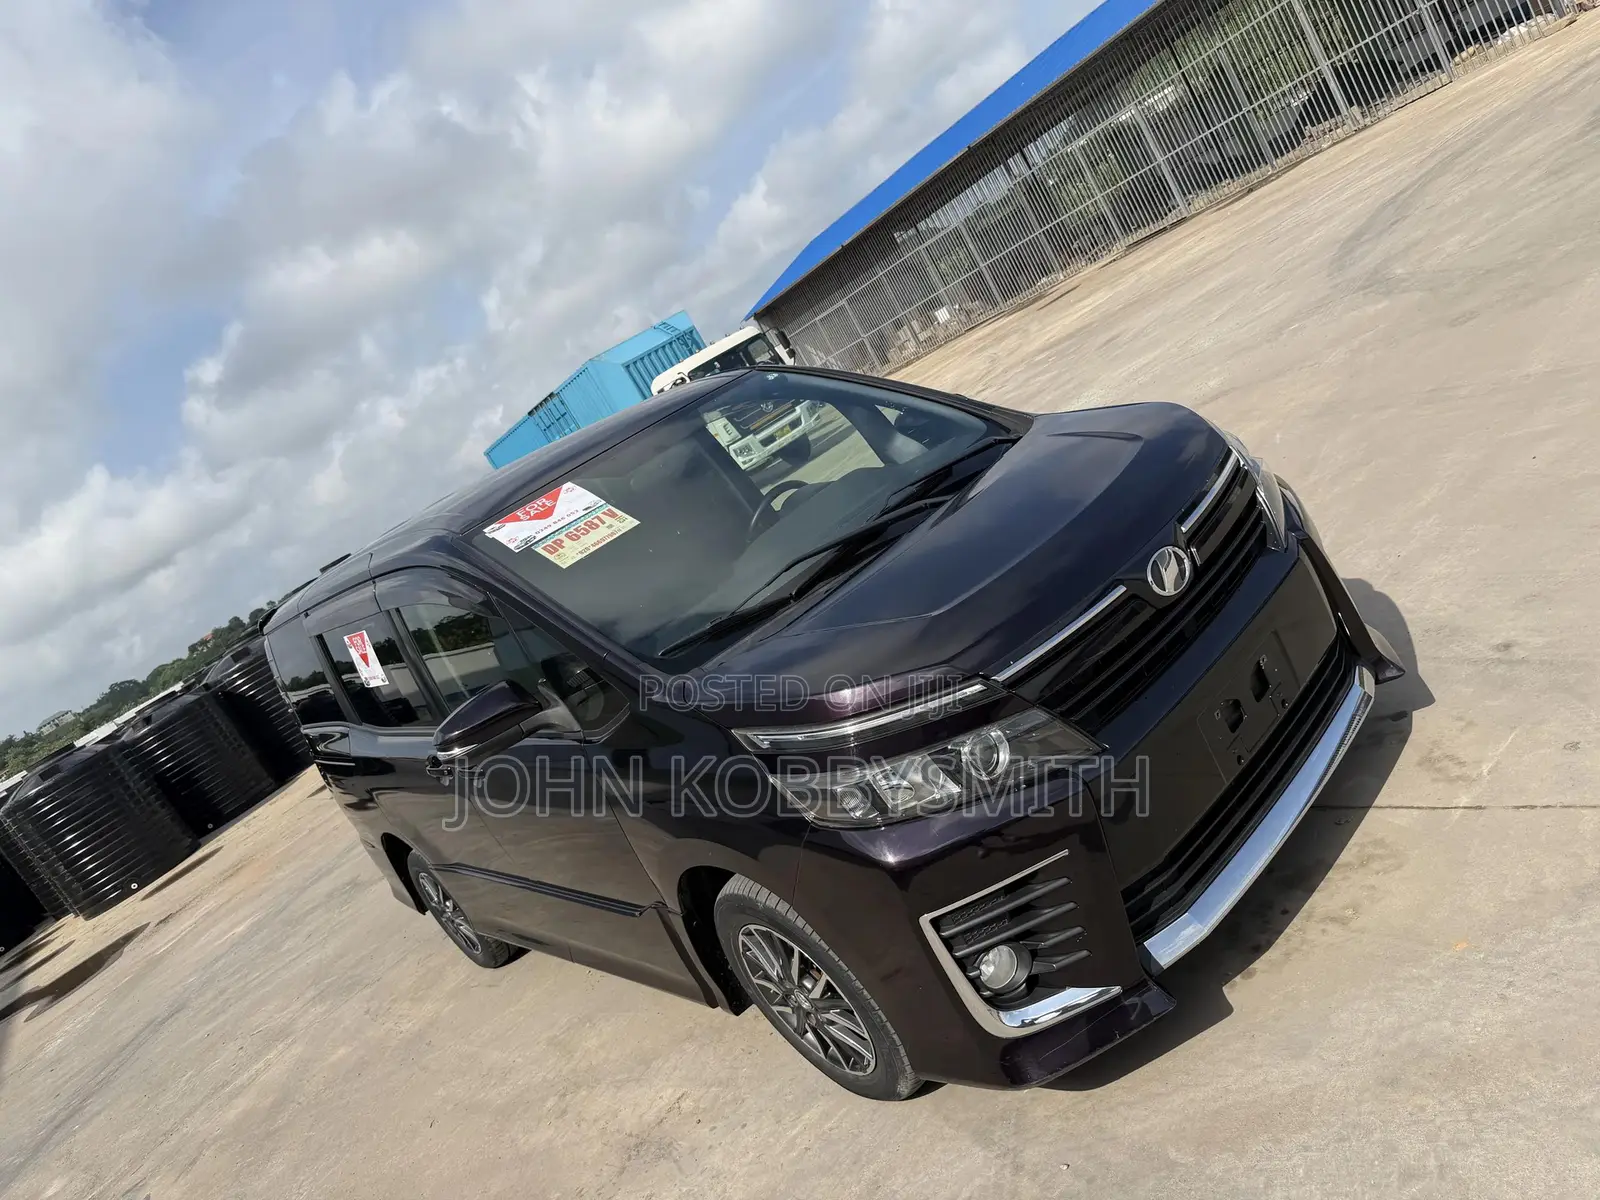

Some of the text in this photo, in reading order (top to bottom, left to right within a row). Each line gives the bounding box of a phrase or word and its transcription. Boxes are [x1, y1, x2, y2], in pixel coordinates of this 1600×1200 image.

[516, 498, 547, 517] FOR
[519, 499, 557, 521] SALE
[541, 539, 566, 556] DP
[565, 515, 606, 542] 6587
[601, 508, 619, 519] V
